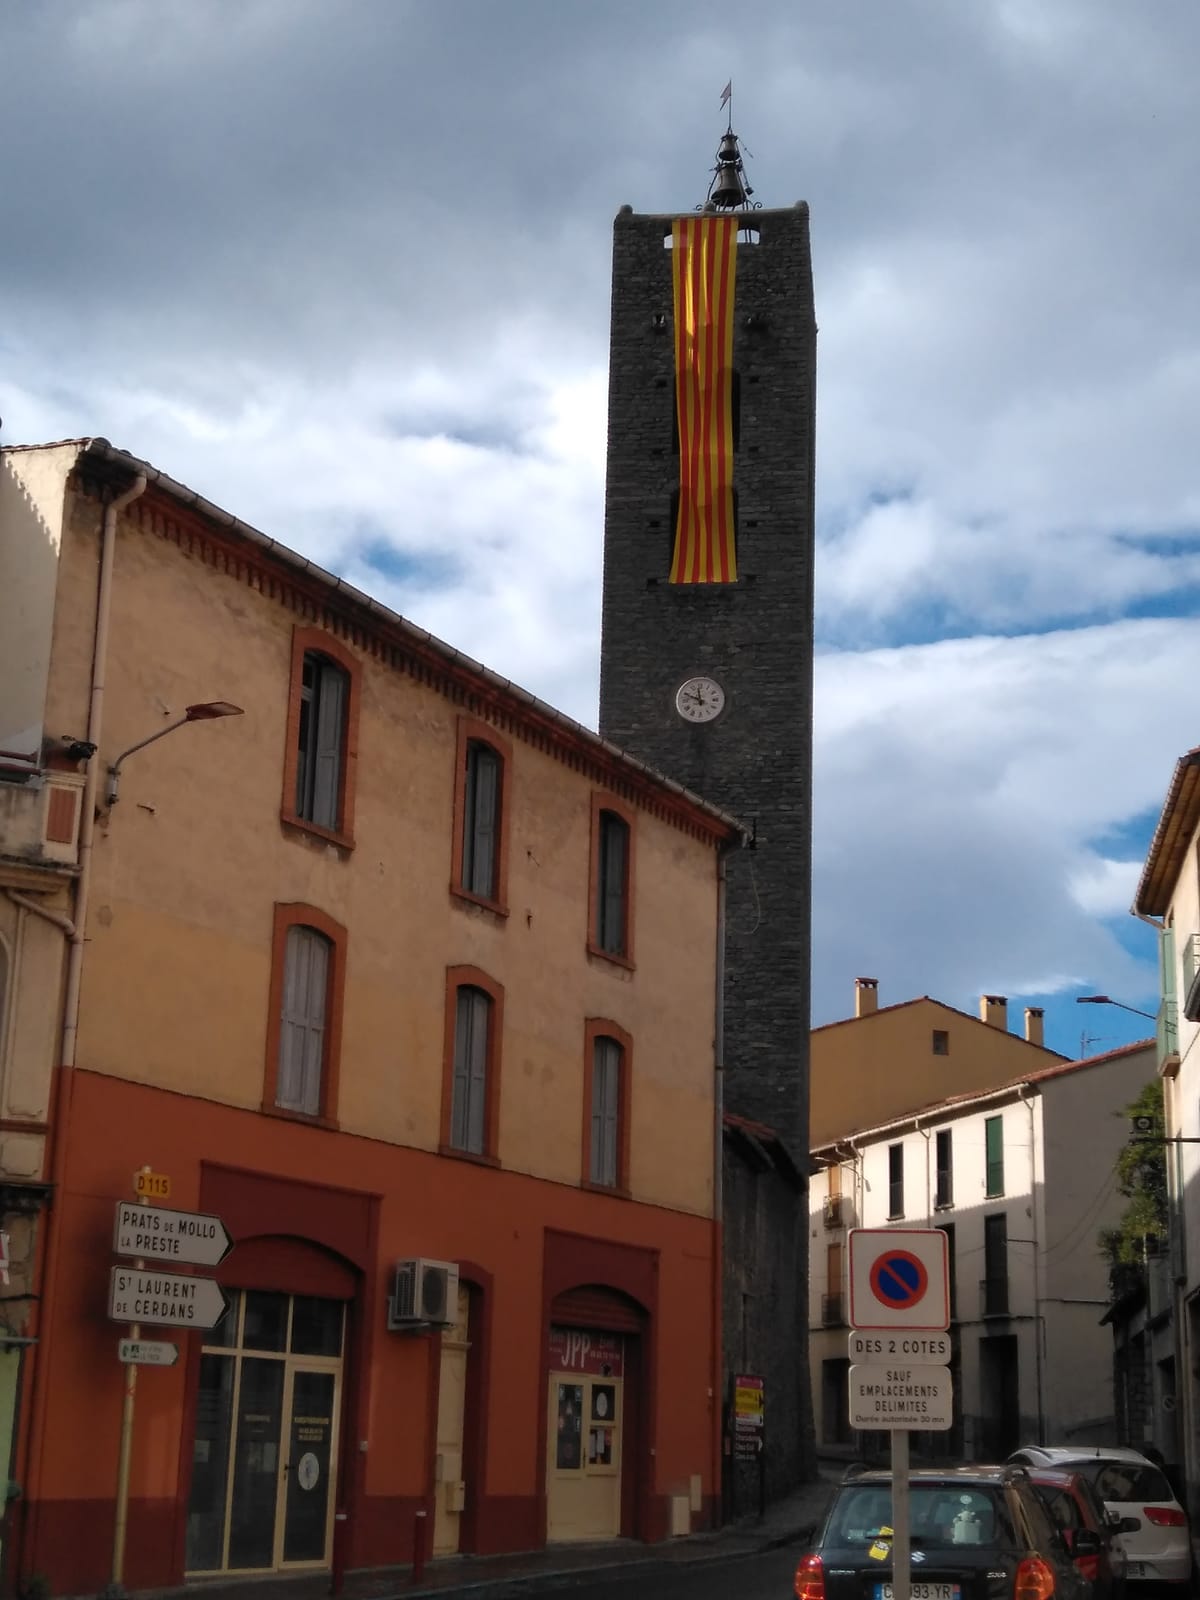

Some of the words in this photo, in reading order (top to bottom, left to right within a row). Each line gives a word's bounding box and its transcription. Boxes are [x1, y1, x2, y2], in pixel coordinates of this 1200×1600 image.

[138, 1176, 145, 1190] D
[149, 1179, 169, 1194] 115
[123, 1211, 160, 1231] PRATS
[164, 1223, 174, 1233] DE
[178, 1219, 216, 1239] MOLLO
[121, 1236, 130, 1248] LA
[136, 1234, 180, 1254] PRESTE
[138, 1278, 197, 1299] LAURENT
[116, 1301, 128, 1313] DE
[134, 1300, 195, 1319] CERDANS
[561, 1331, 592, 1369] JPP
[855, 1340, 882, 1353] DES
[888, 1340, 896, 1353] 2
[903, 1341, 946, 1354] COTES
[886, 1370, 912, 1382] SAUF
[860, 1385, 939, 1397] EMPLACEMENTS
[875, 1401, 928, 1413] DELIMITES
